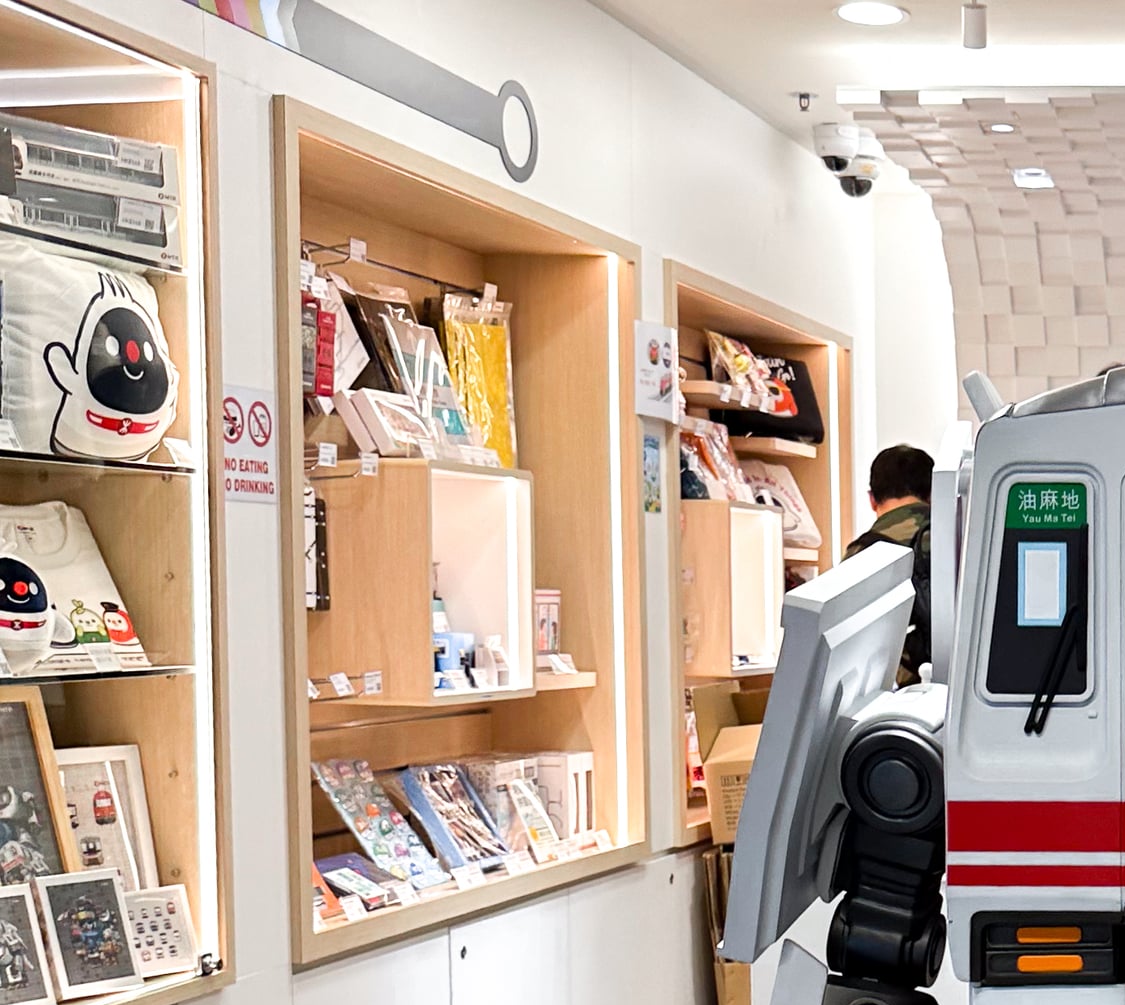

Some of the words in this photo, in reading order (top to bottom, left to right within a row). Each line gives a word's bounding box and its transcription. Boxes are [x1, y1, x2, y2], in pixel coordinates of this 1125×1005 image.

[224, 457, 237, 471] NO
[239, 459, 269, 474] EATING
[234, 479, 274, 494] DRINKING
[1018, 488, 1080, 511] 油麻地
[1022, 513, 1041, 523] Yau
[1043, 513, 1059, 523] Ma
[1060, 513, 1076, 523] Tei
